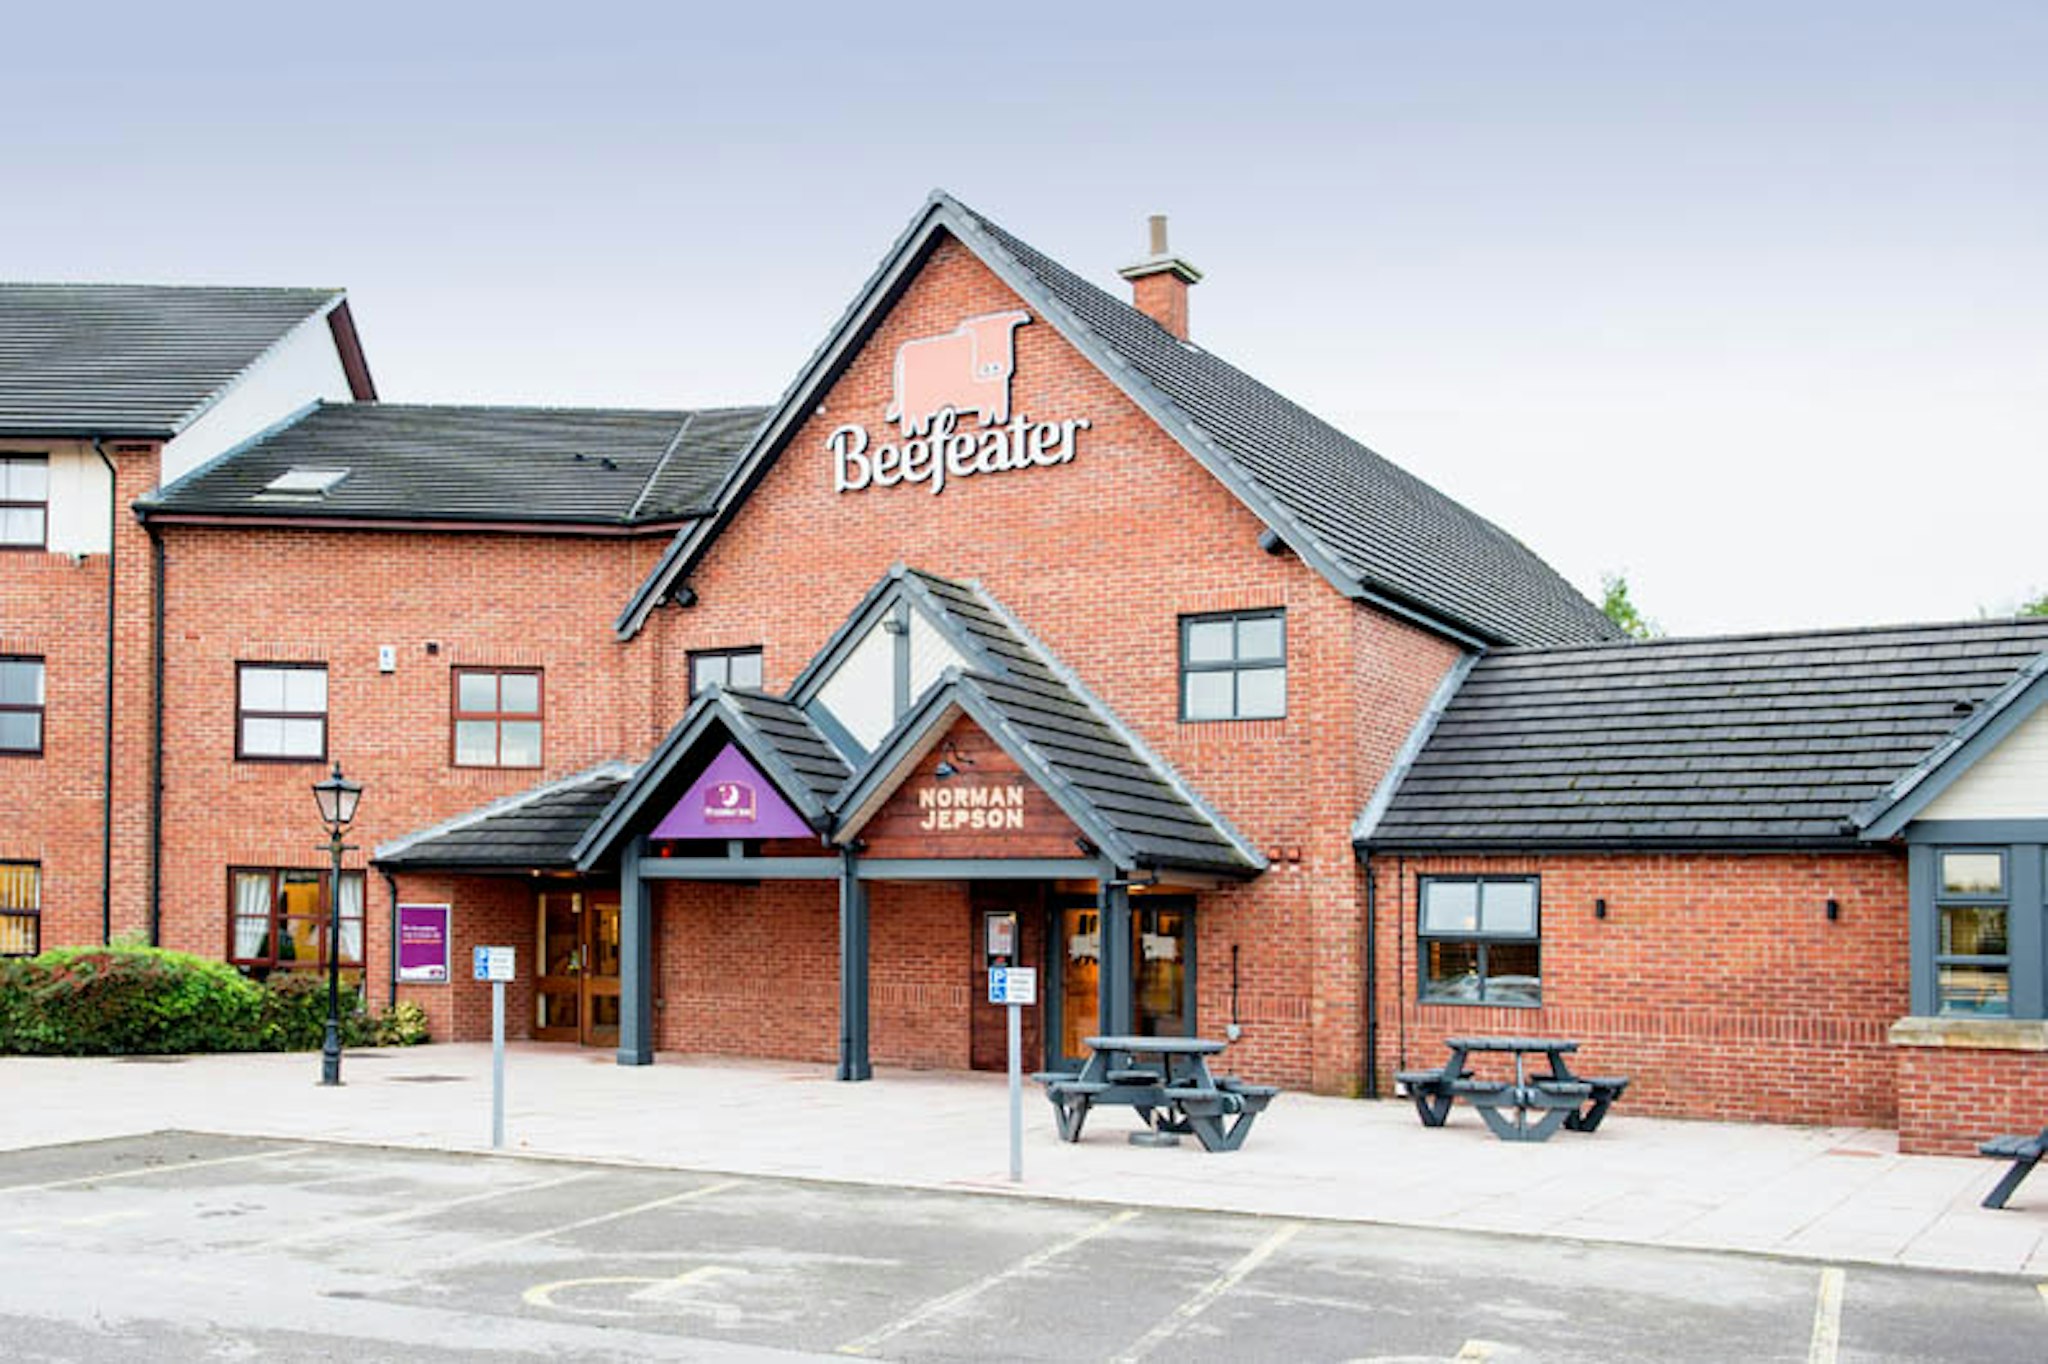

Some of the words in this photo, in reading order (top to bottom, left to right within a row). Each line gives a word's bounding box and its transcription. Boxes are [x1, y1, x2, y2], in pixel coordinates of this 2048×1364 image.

[826, 407, 1091, 494] Beefeater
[919, 785, 1024, 808] NORMAN
[920, 807, 1024, 830] JEPSON
